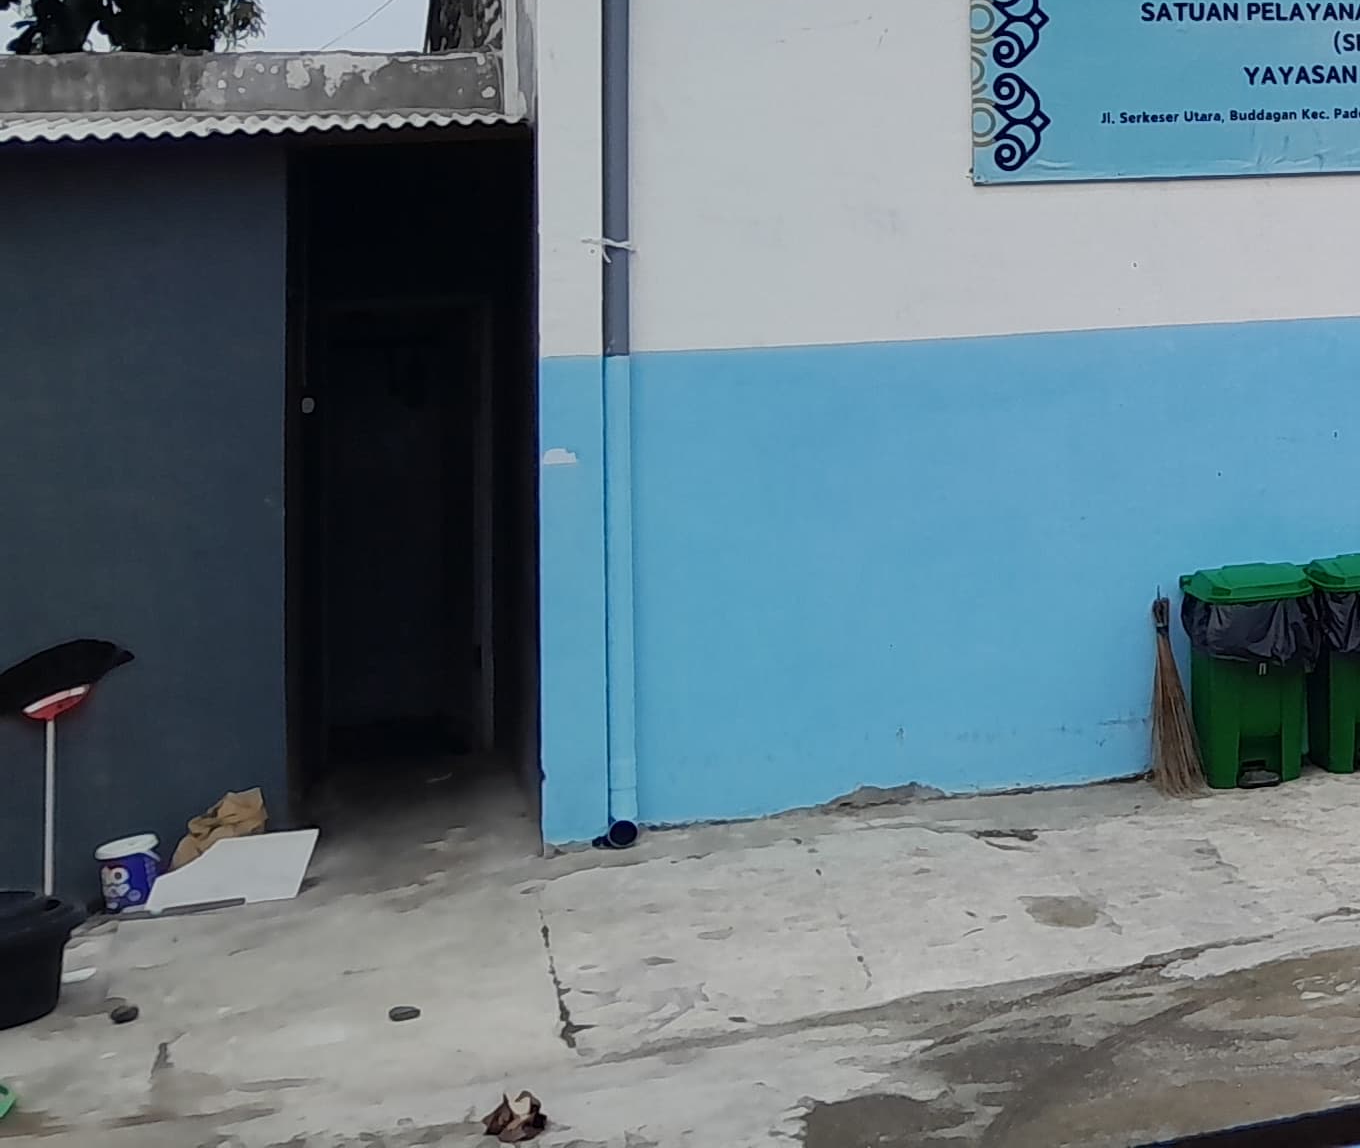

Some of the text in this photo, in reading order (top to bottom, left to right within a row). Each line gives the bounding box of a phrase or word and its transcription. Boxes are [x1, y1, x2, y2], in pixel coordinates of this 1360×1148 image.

[1140, 1, 1239, 22] SATUAN
[1243, 64, 1358, 86] YAYASAN
[1119, 111, 1180, 124] Serkeser
[1183, 110, 1225, 124] Utara,
[1229, 108, 1298, 124] Buddagan
[1301, 108, 1331, 121] Kec.
